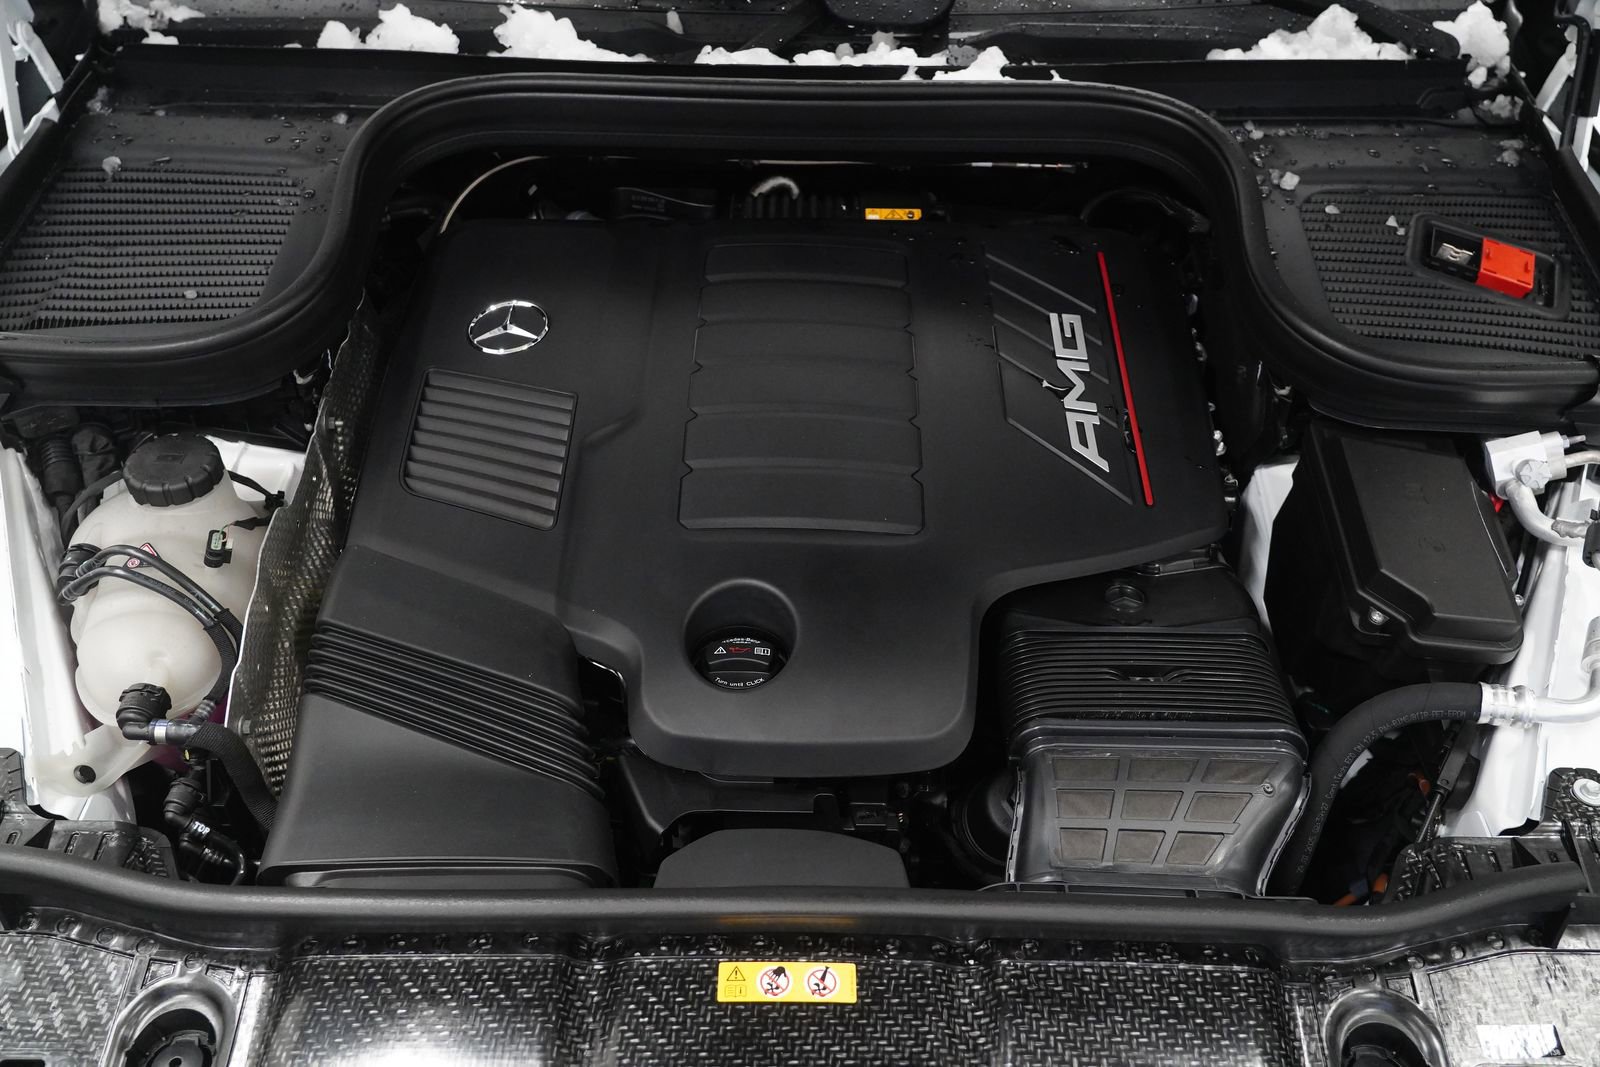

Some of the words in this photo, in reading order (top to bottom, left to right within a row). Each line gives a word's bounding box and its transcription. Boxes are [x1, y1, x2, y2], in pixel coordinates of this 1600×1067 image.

[1049, 313, 1110, 473] AMG
[715, 677, 728, 686] Turn
[746, 678, 765, 687] CLICK
[193, 821, 211, 835] TOP
